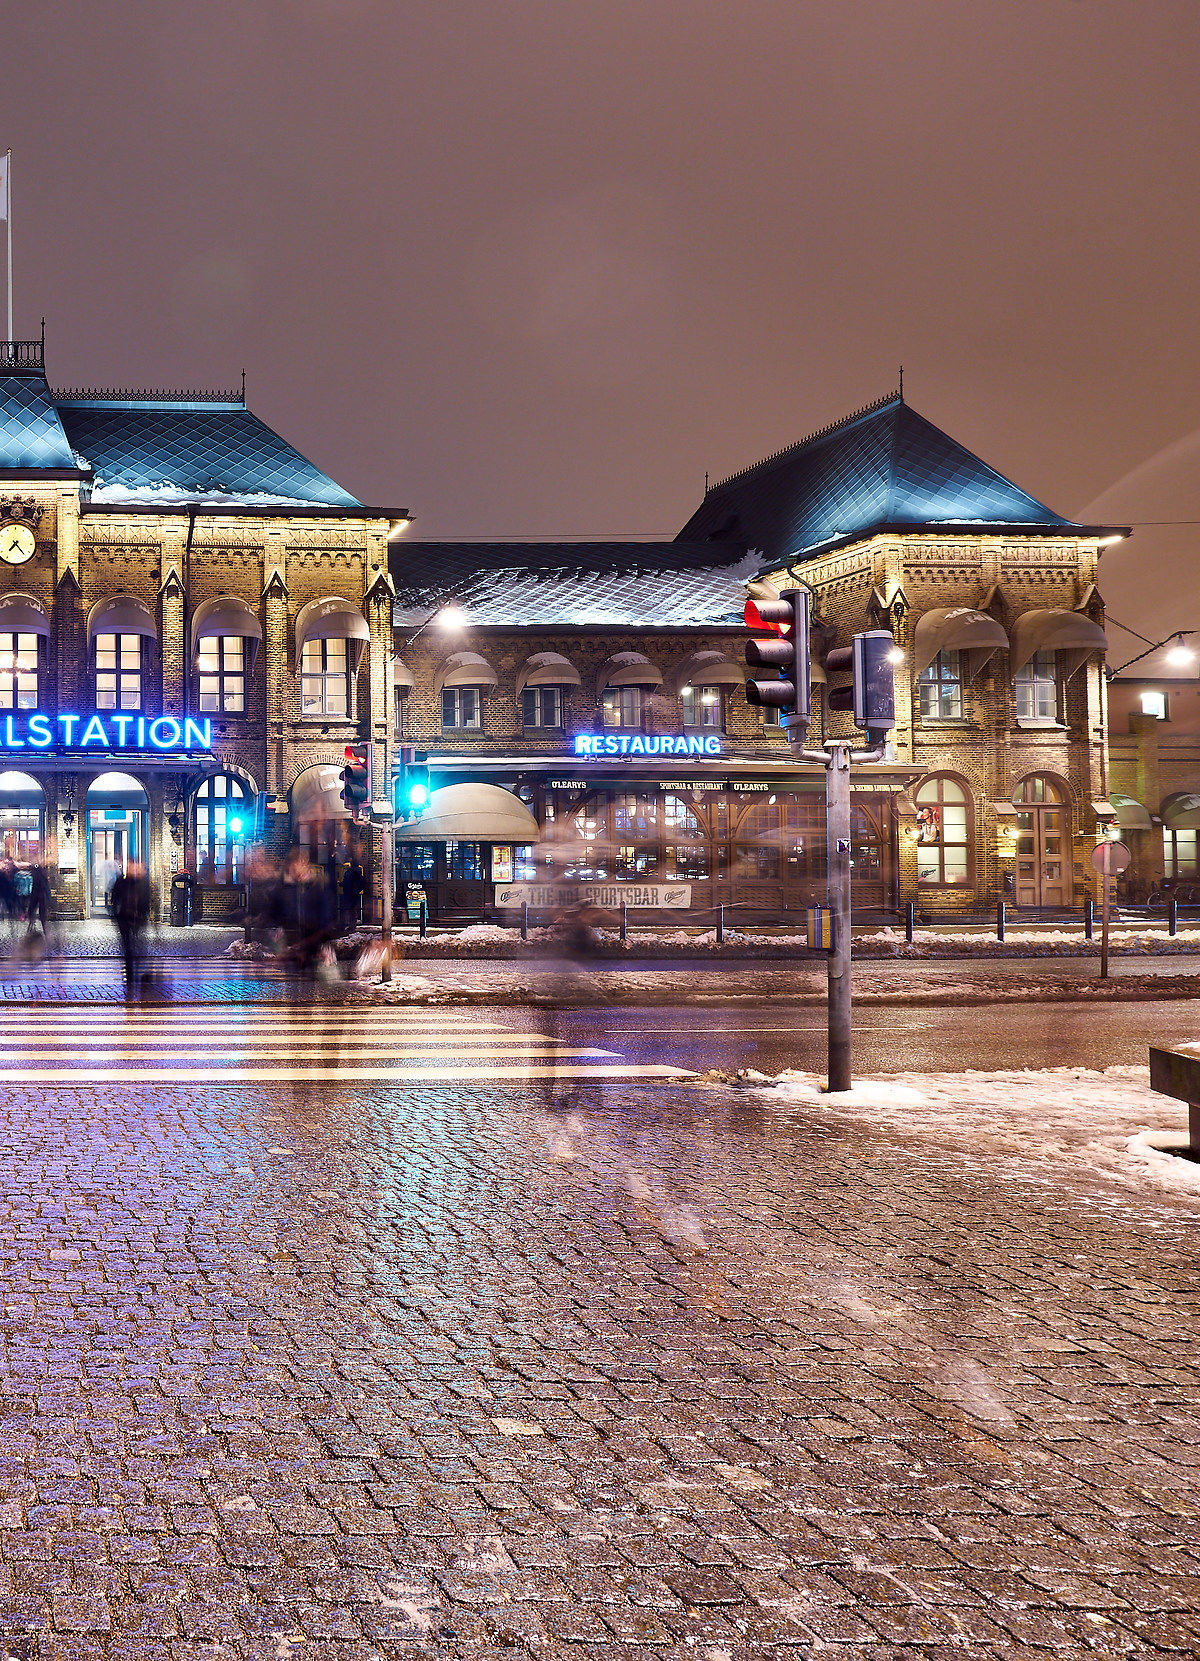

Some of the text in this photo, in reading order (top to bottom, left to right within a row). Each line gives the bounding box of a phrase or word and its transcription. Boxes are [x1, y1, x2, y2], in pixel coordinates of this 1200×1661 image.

[575, 735, 721, 754] RESTAURANG
[528, 887, 554, 906] THE
[585, 887, 660, 906] SPORTSBAR
